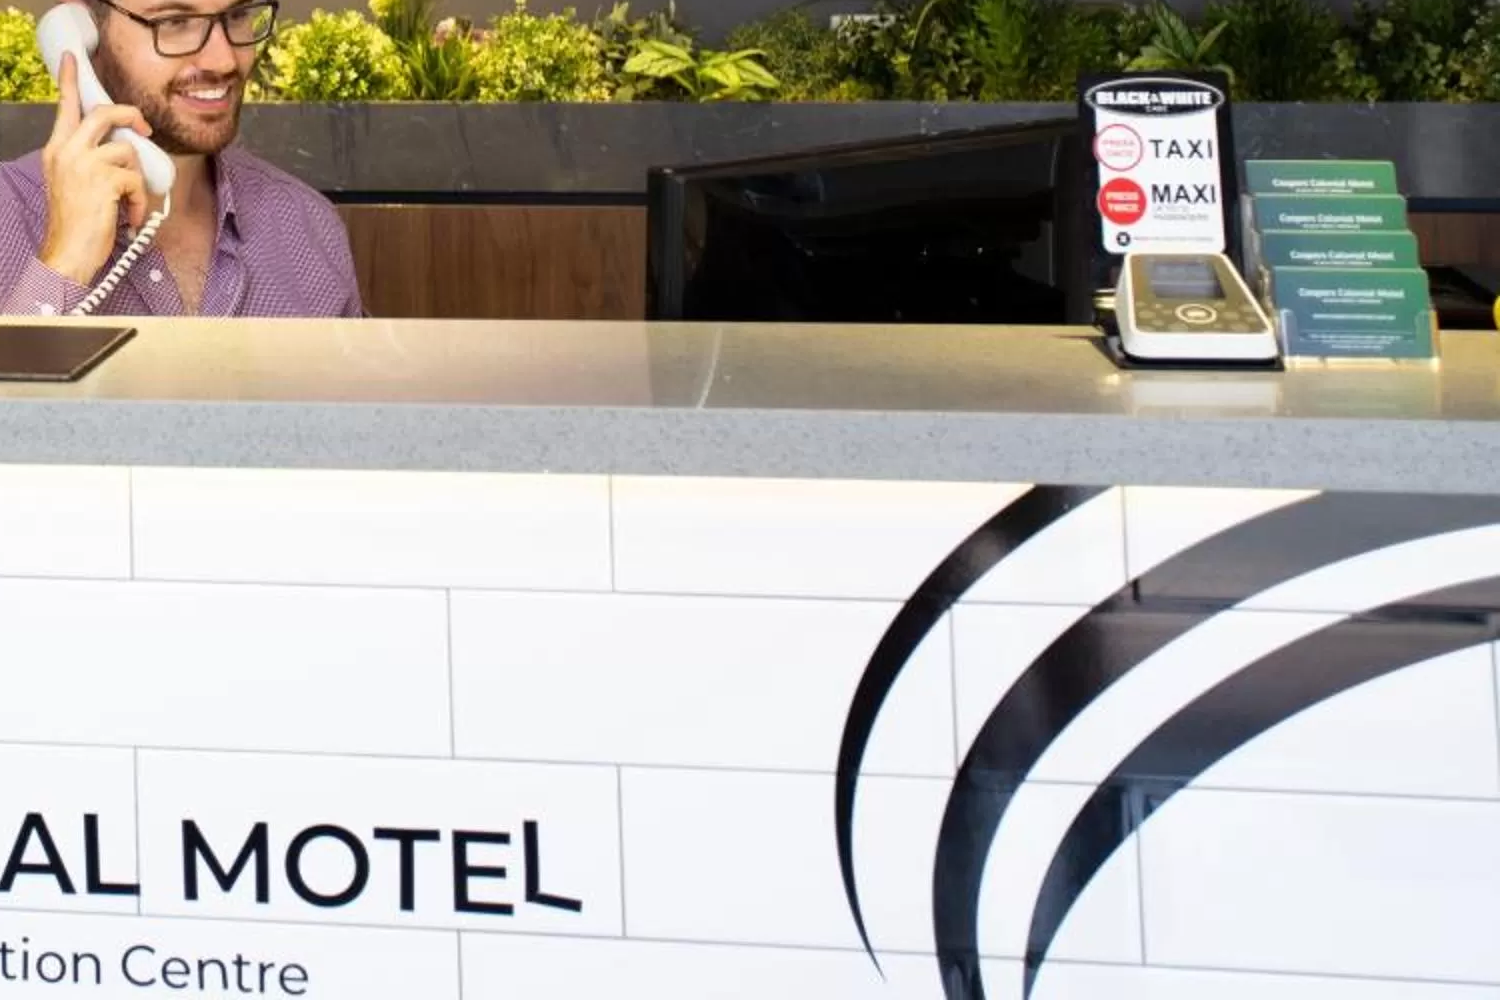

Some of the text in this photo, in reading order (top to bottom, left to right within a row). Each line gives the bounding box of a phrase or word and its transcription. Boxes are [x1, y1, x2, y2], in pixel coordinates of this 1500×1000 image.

[1148, 138, 1214, 159] TAXI
[1151, 183, 1217, 204] MAXI
[181, 818, 583, 917] MOTEL
[119, 944, 311, 996] Centre
